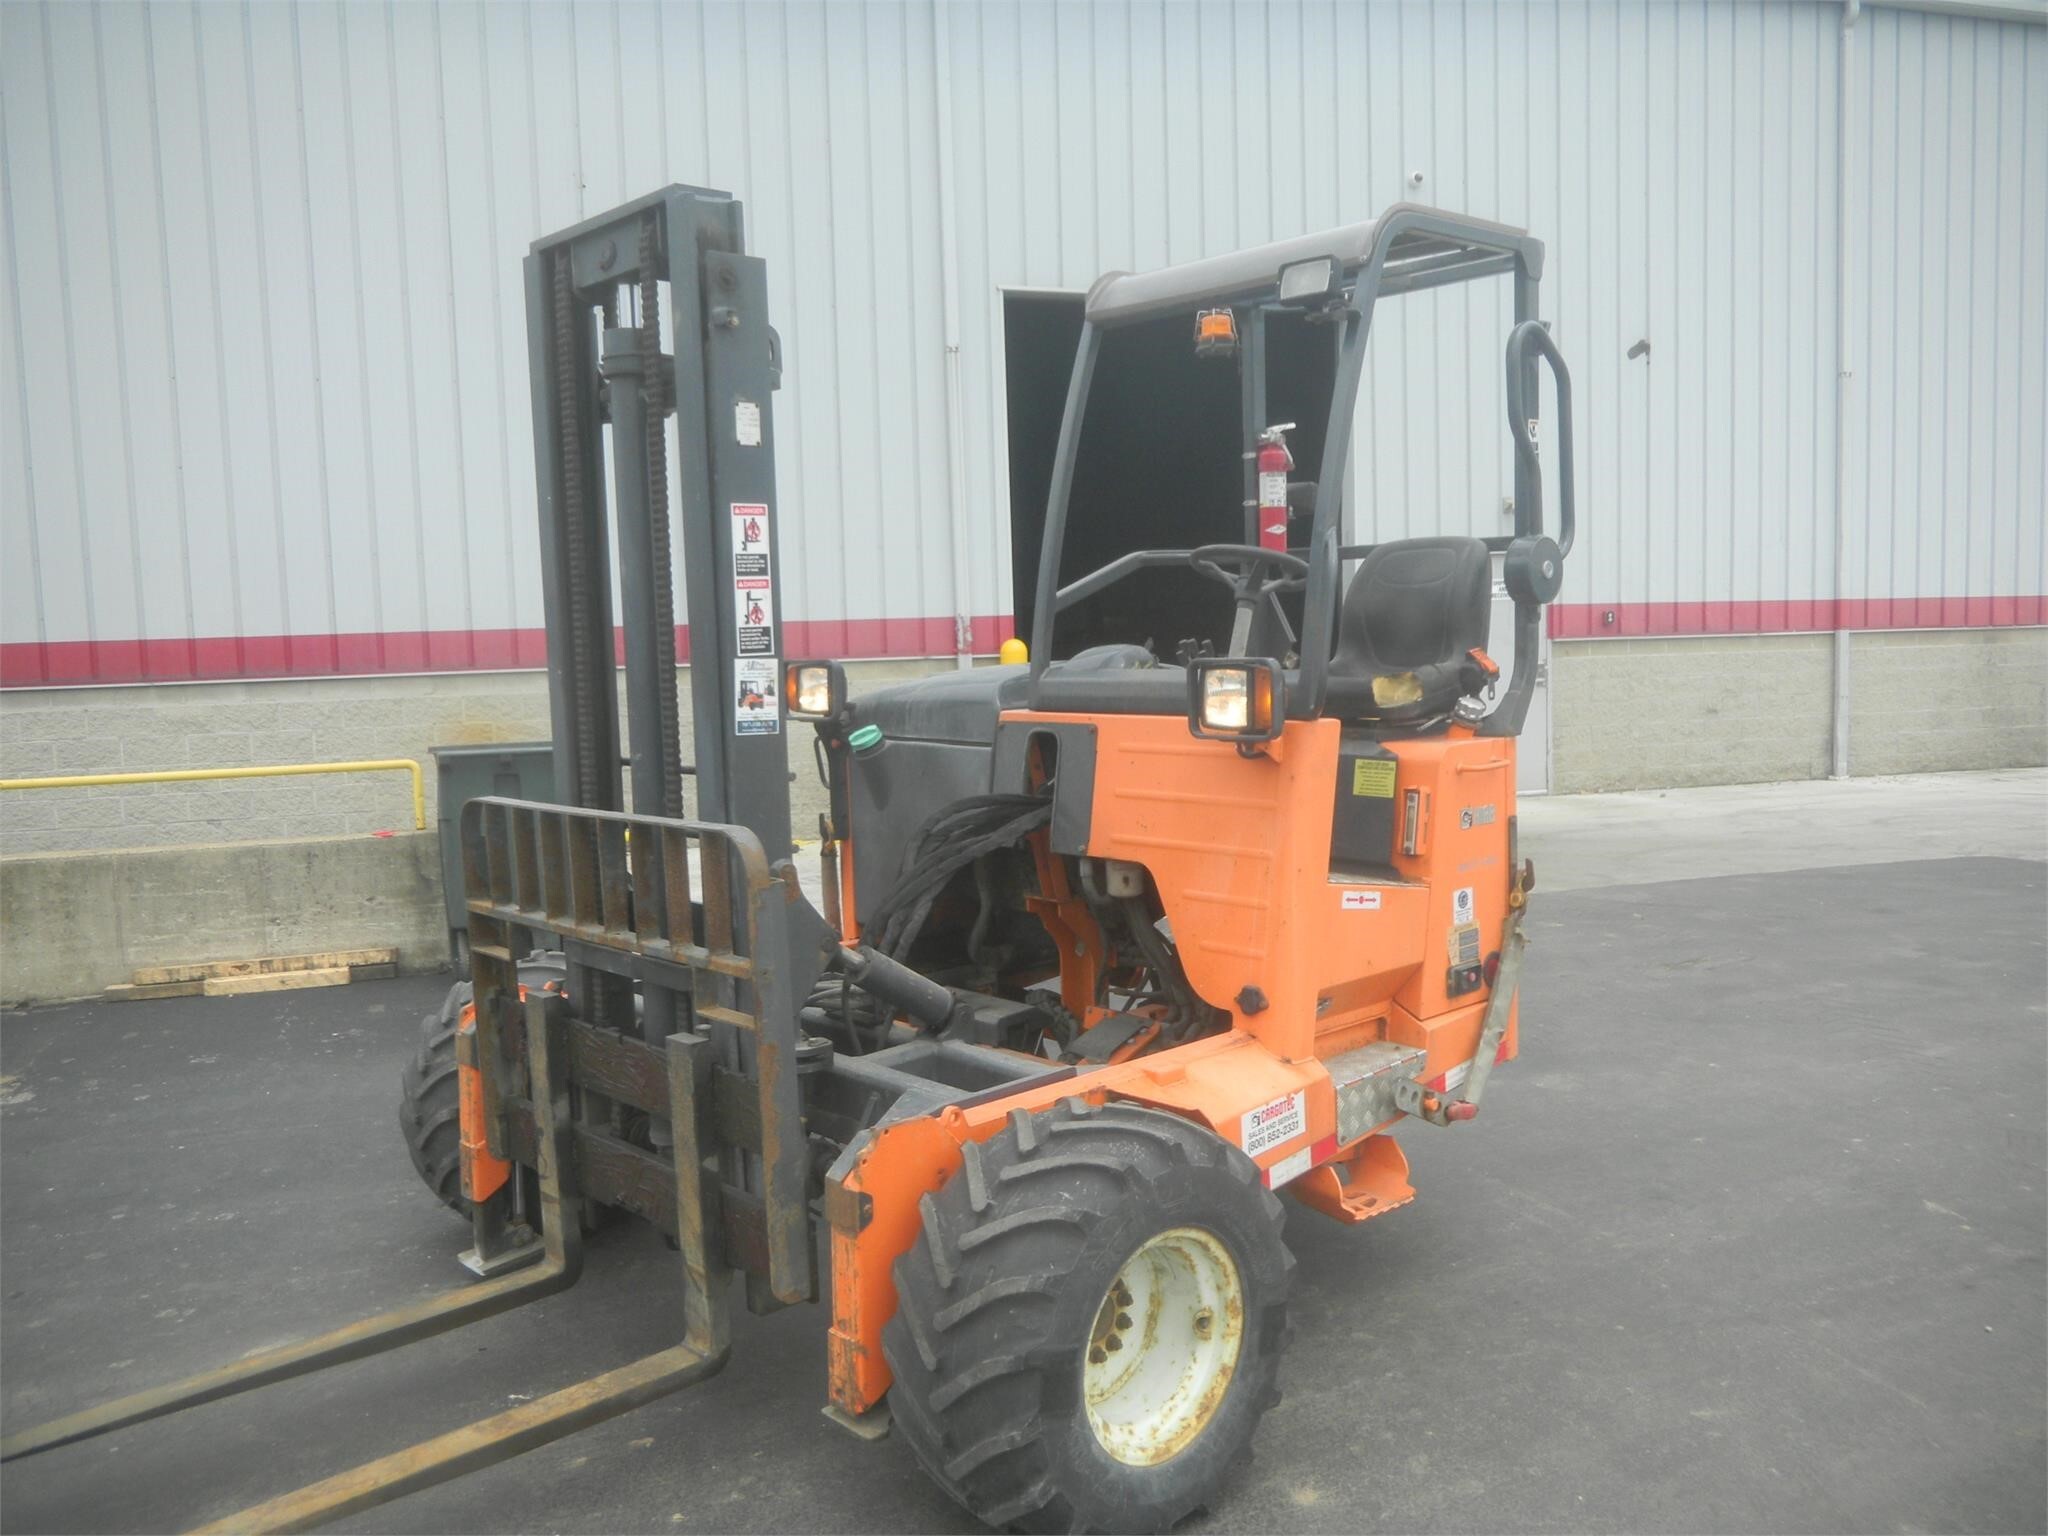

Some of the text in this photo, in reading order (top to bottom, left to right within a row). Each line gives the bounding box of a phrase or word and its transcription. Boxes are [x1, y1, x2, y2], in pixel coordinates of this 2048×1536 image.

[1261, 1096, 1295, 1124] CARGOTEC
[1248, 1110, 1299, 1140] SALES AND SERVICE
